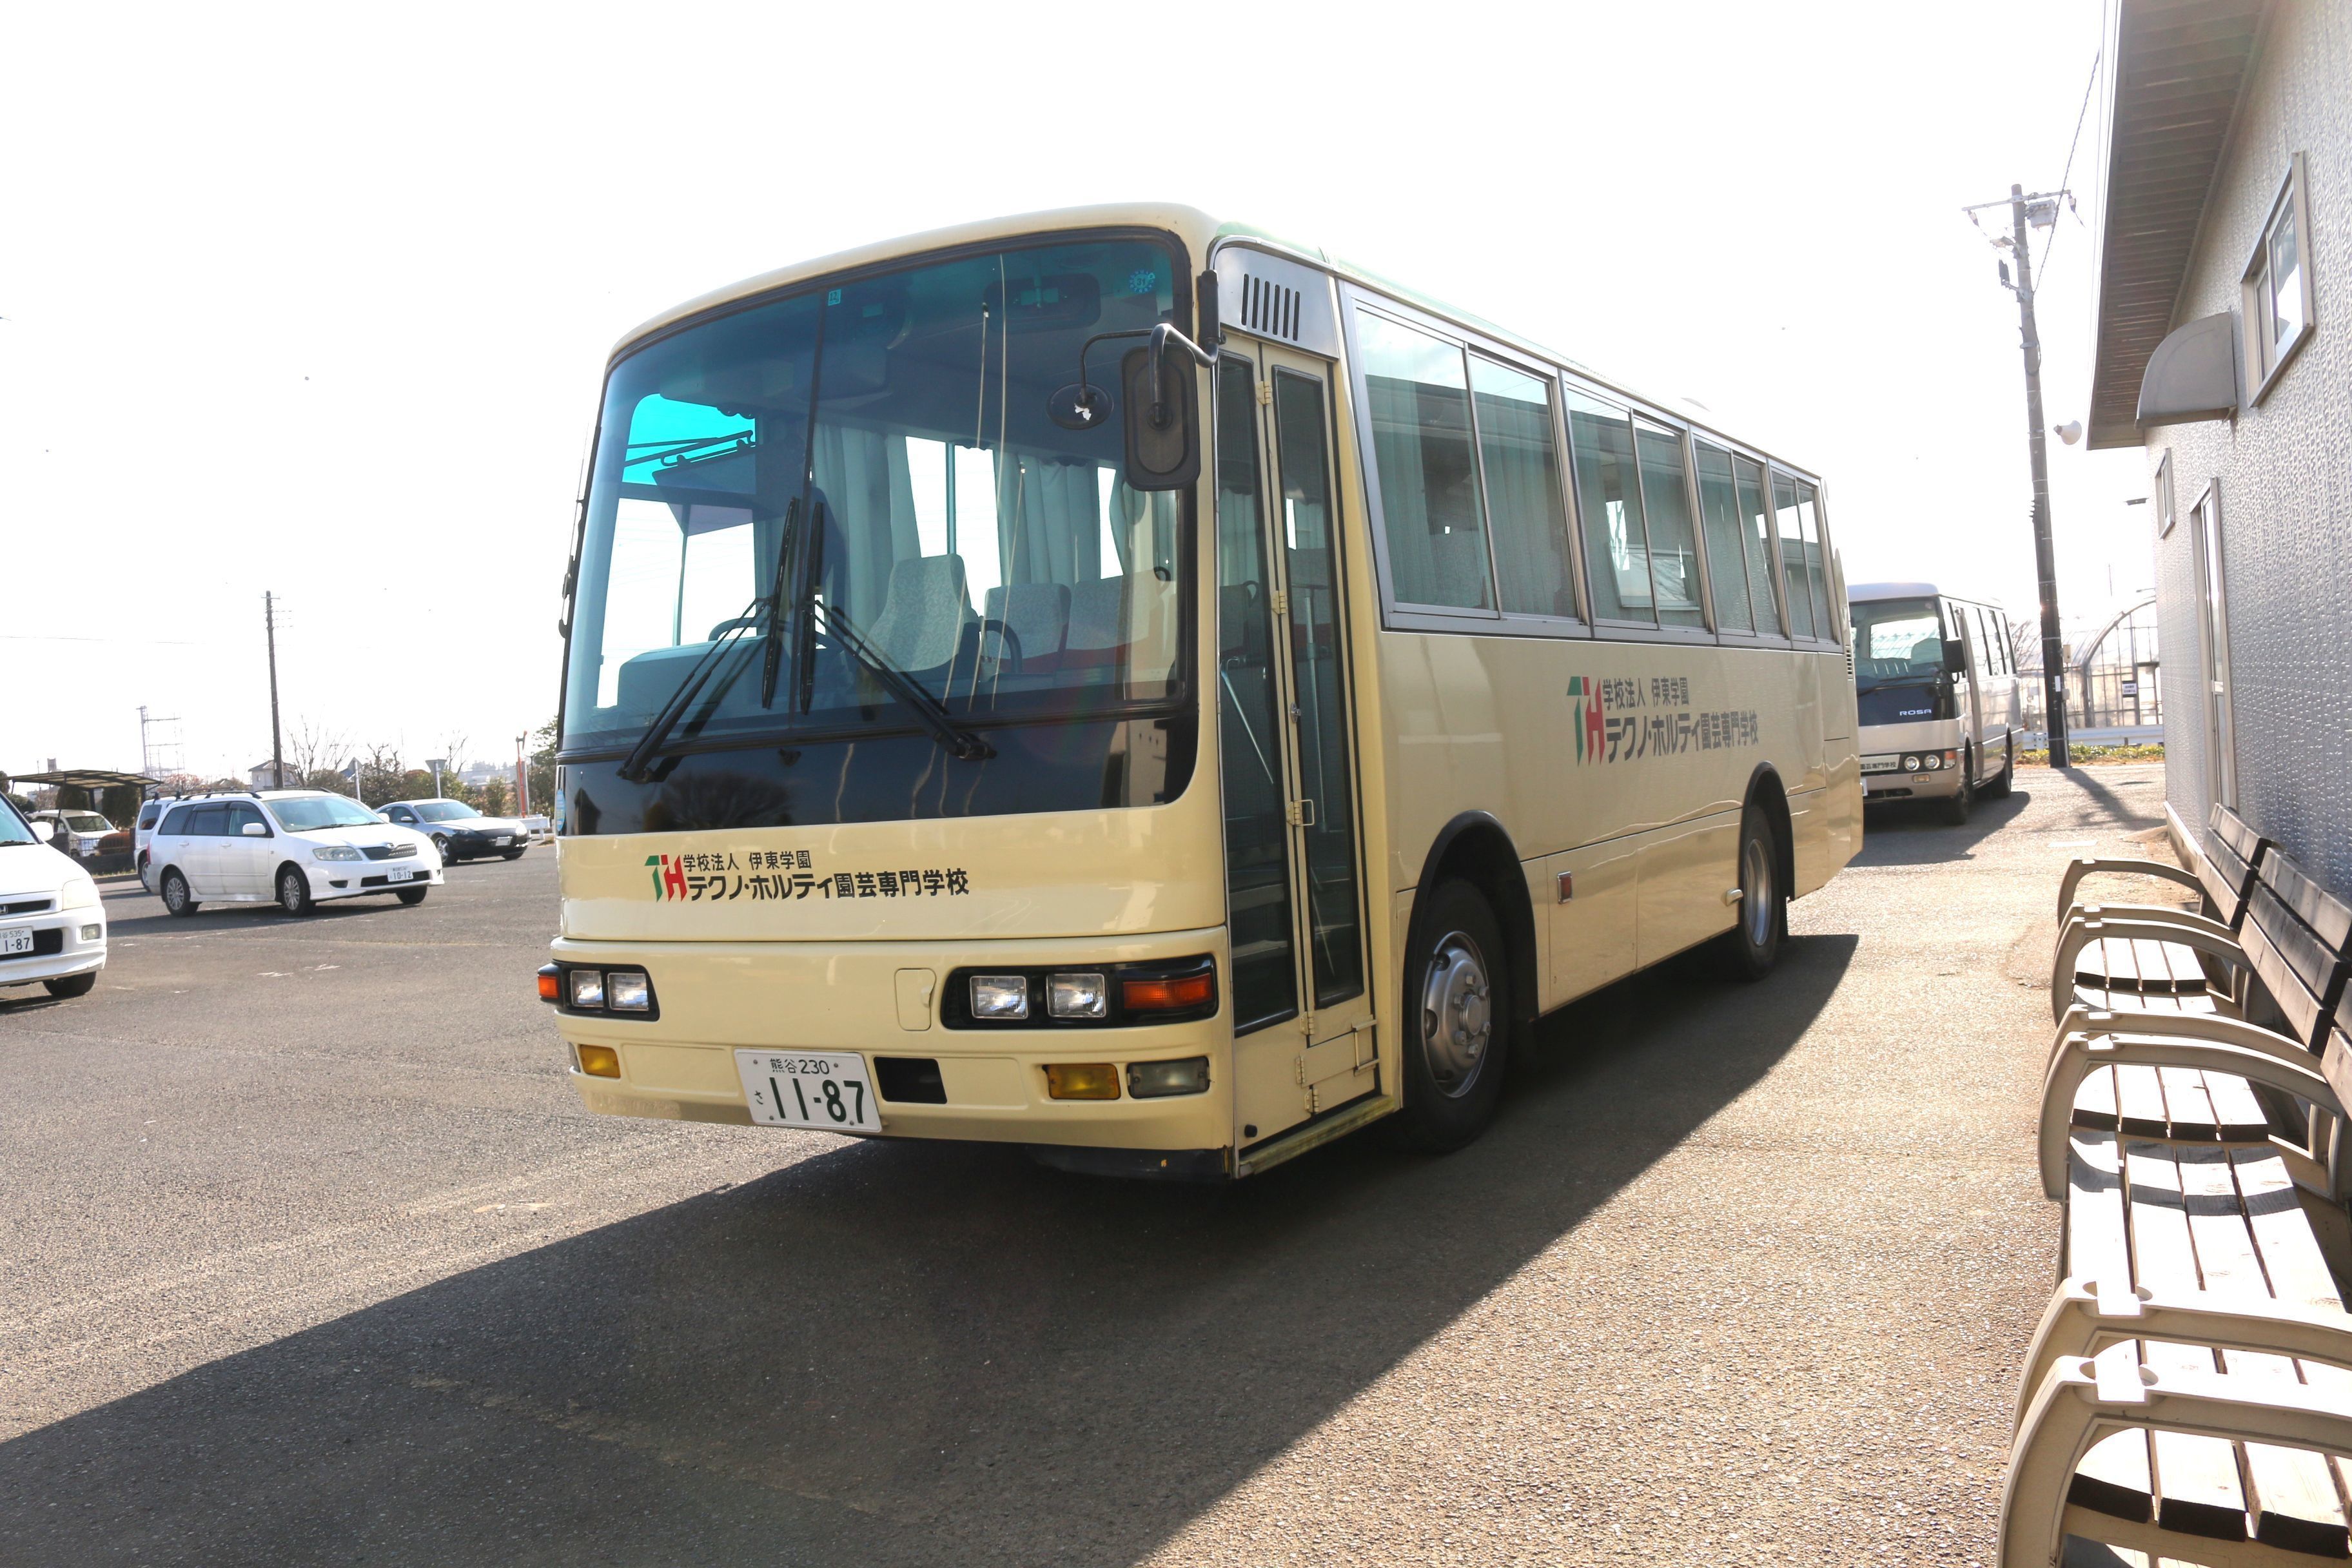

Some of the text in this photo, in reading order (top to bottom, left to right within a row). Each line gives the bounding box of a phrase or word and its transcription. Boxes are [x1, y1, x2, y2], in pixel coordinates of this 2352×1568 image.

[1603, 677, 1689, 710] 学校法人 伊東学園
[683, 850, 812, 872] 学校法人 伊東学園
[688, 868, 969, 901] テクノ・ホルティ園芸専門学校
[754, 1077, 864, 1124] さ 11-87
